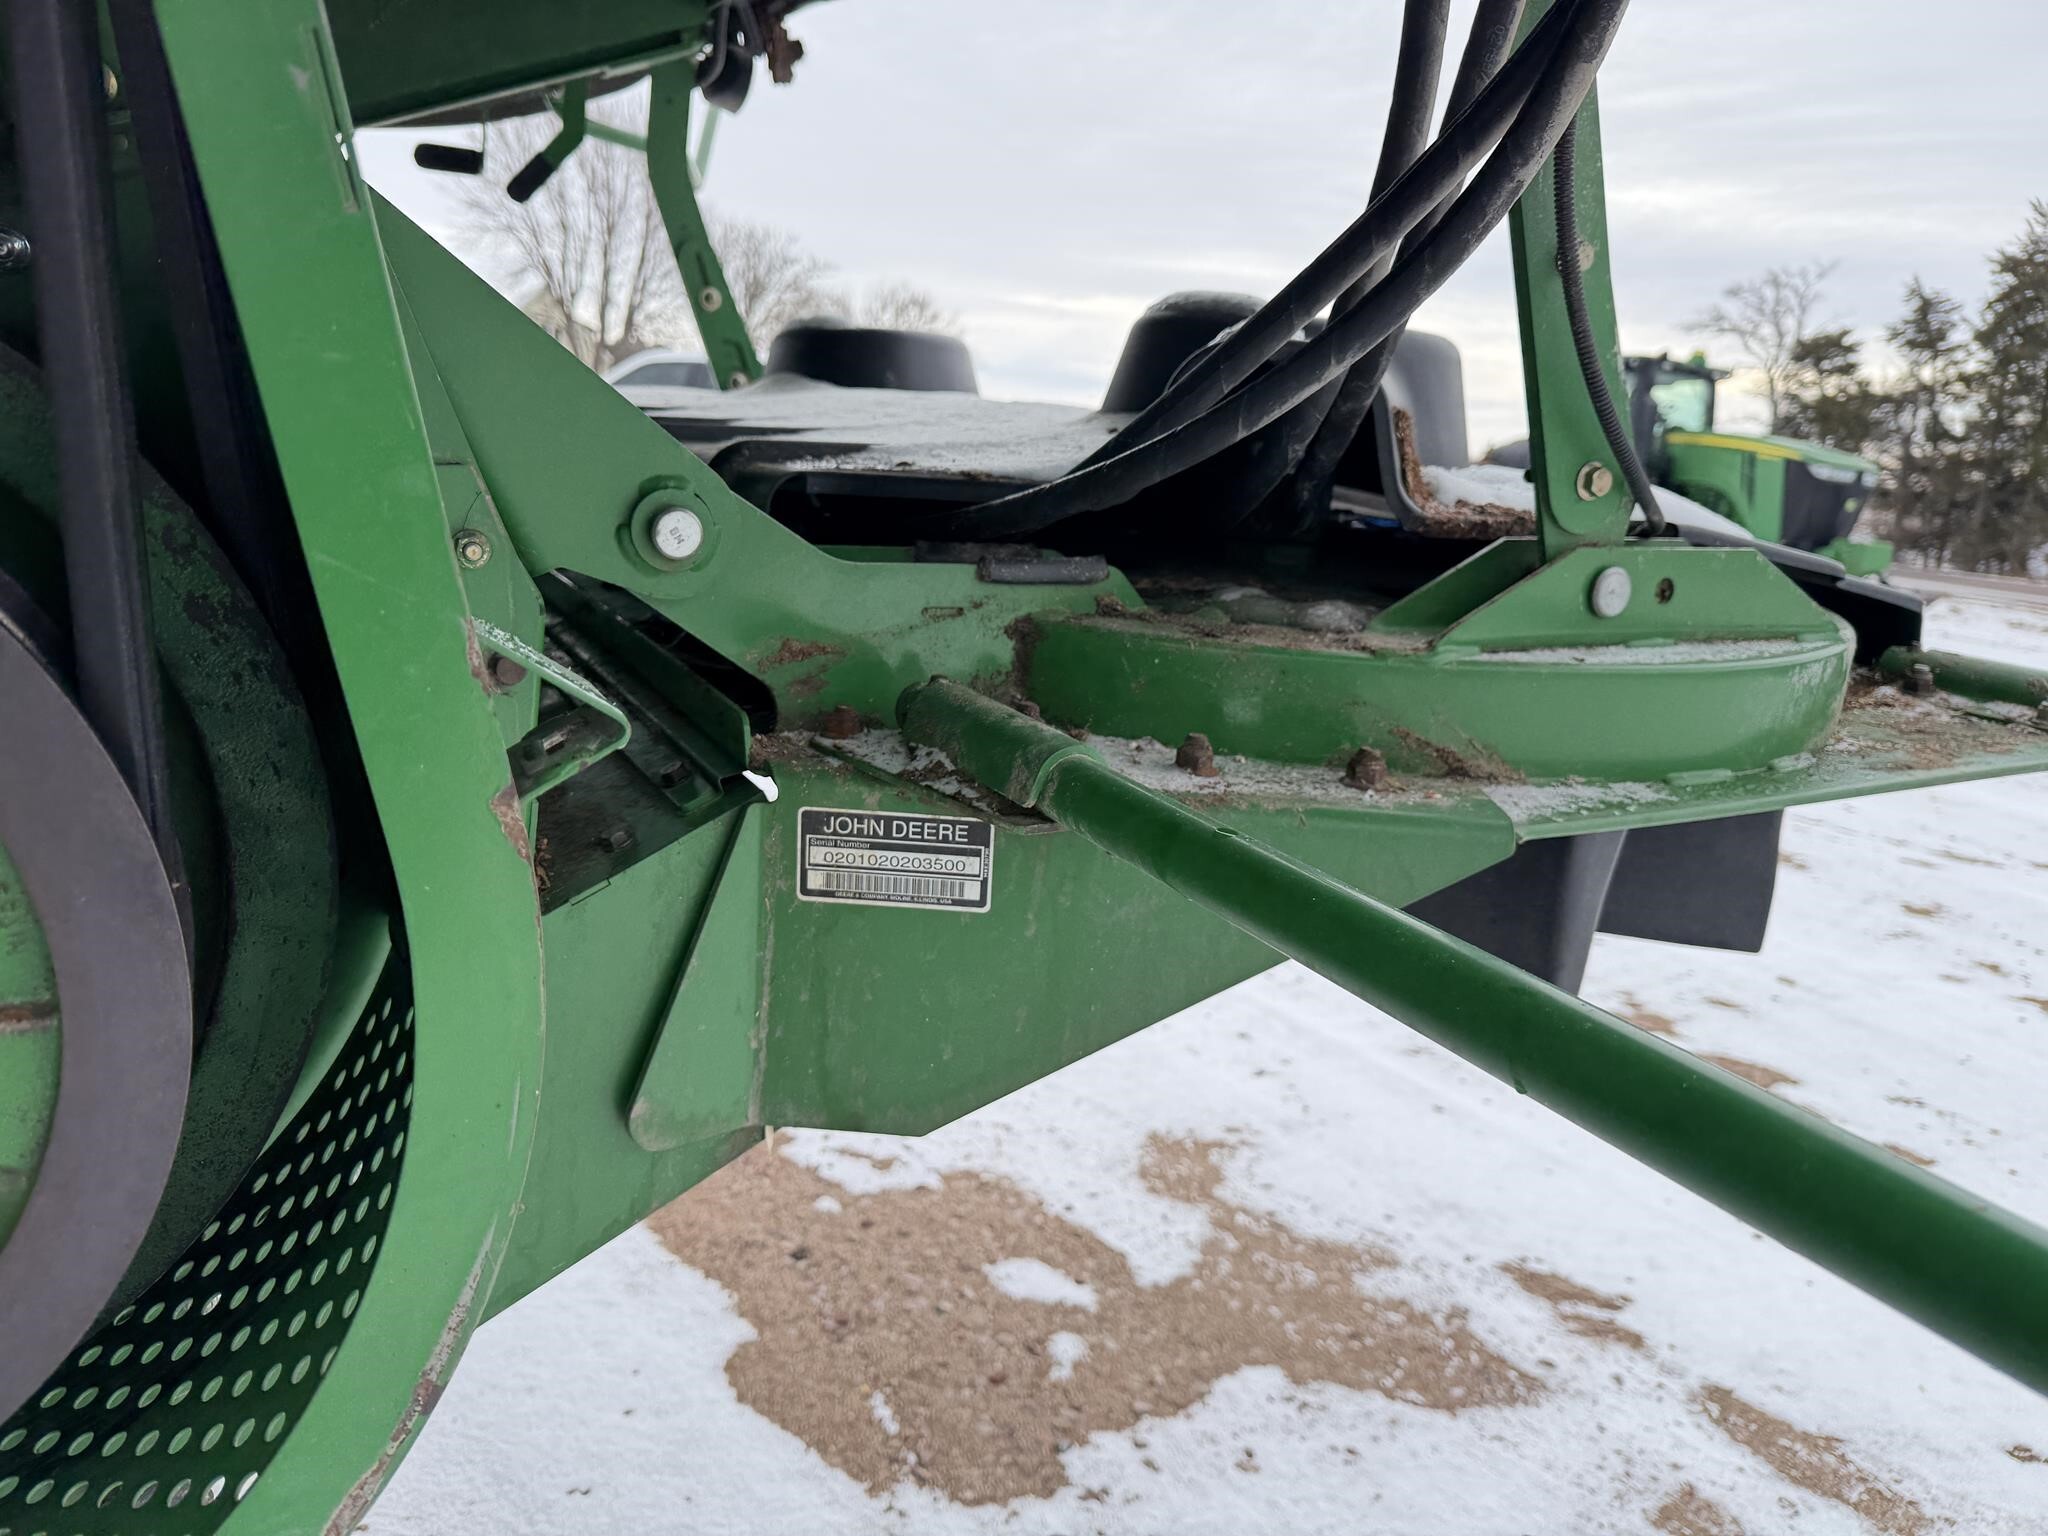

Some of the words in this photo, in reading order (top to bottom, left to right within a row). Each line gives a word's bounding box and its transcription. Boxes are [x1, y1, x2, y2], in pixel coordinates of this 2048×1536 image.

[823, 816, 885, 837] JOHN
[892, 820, 969, 842] DEERE
[810, 838, 835, 847] Serial
[837, 840, 871, 849] Number
[823, 851, 966, 872] 0201020203500
